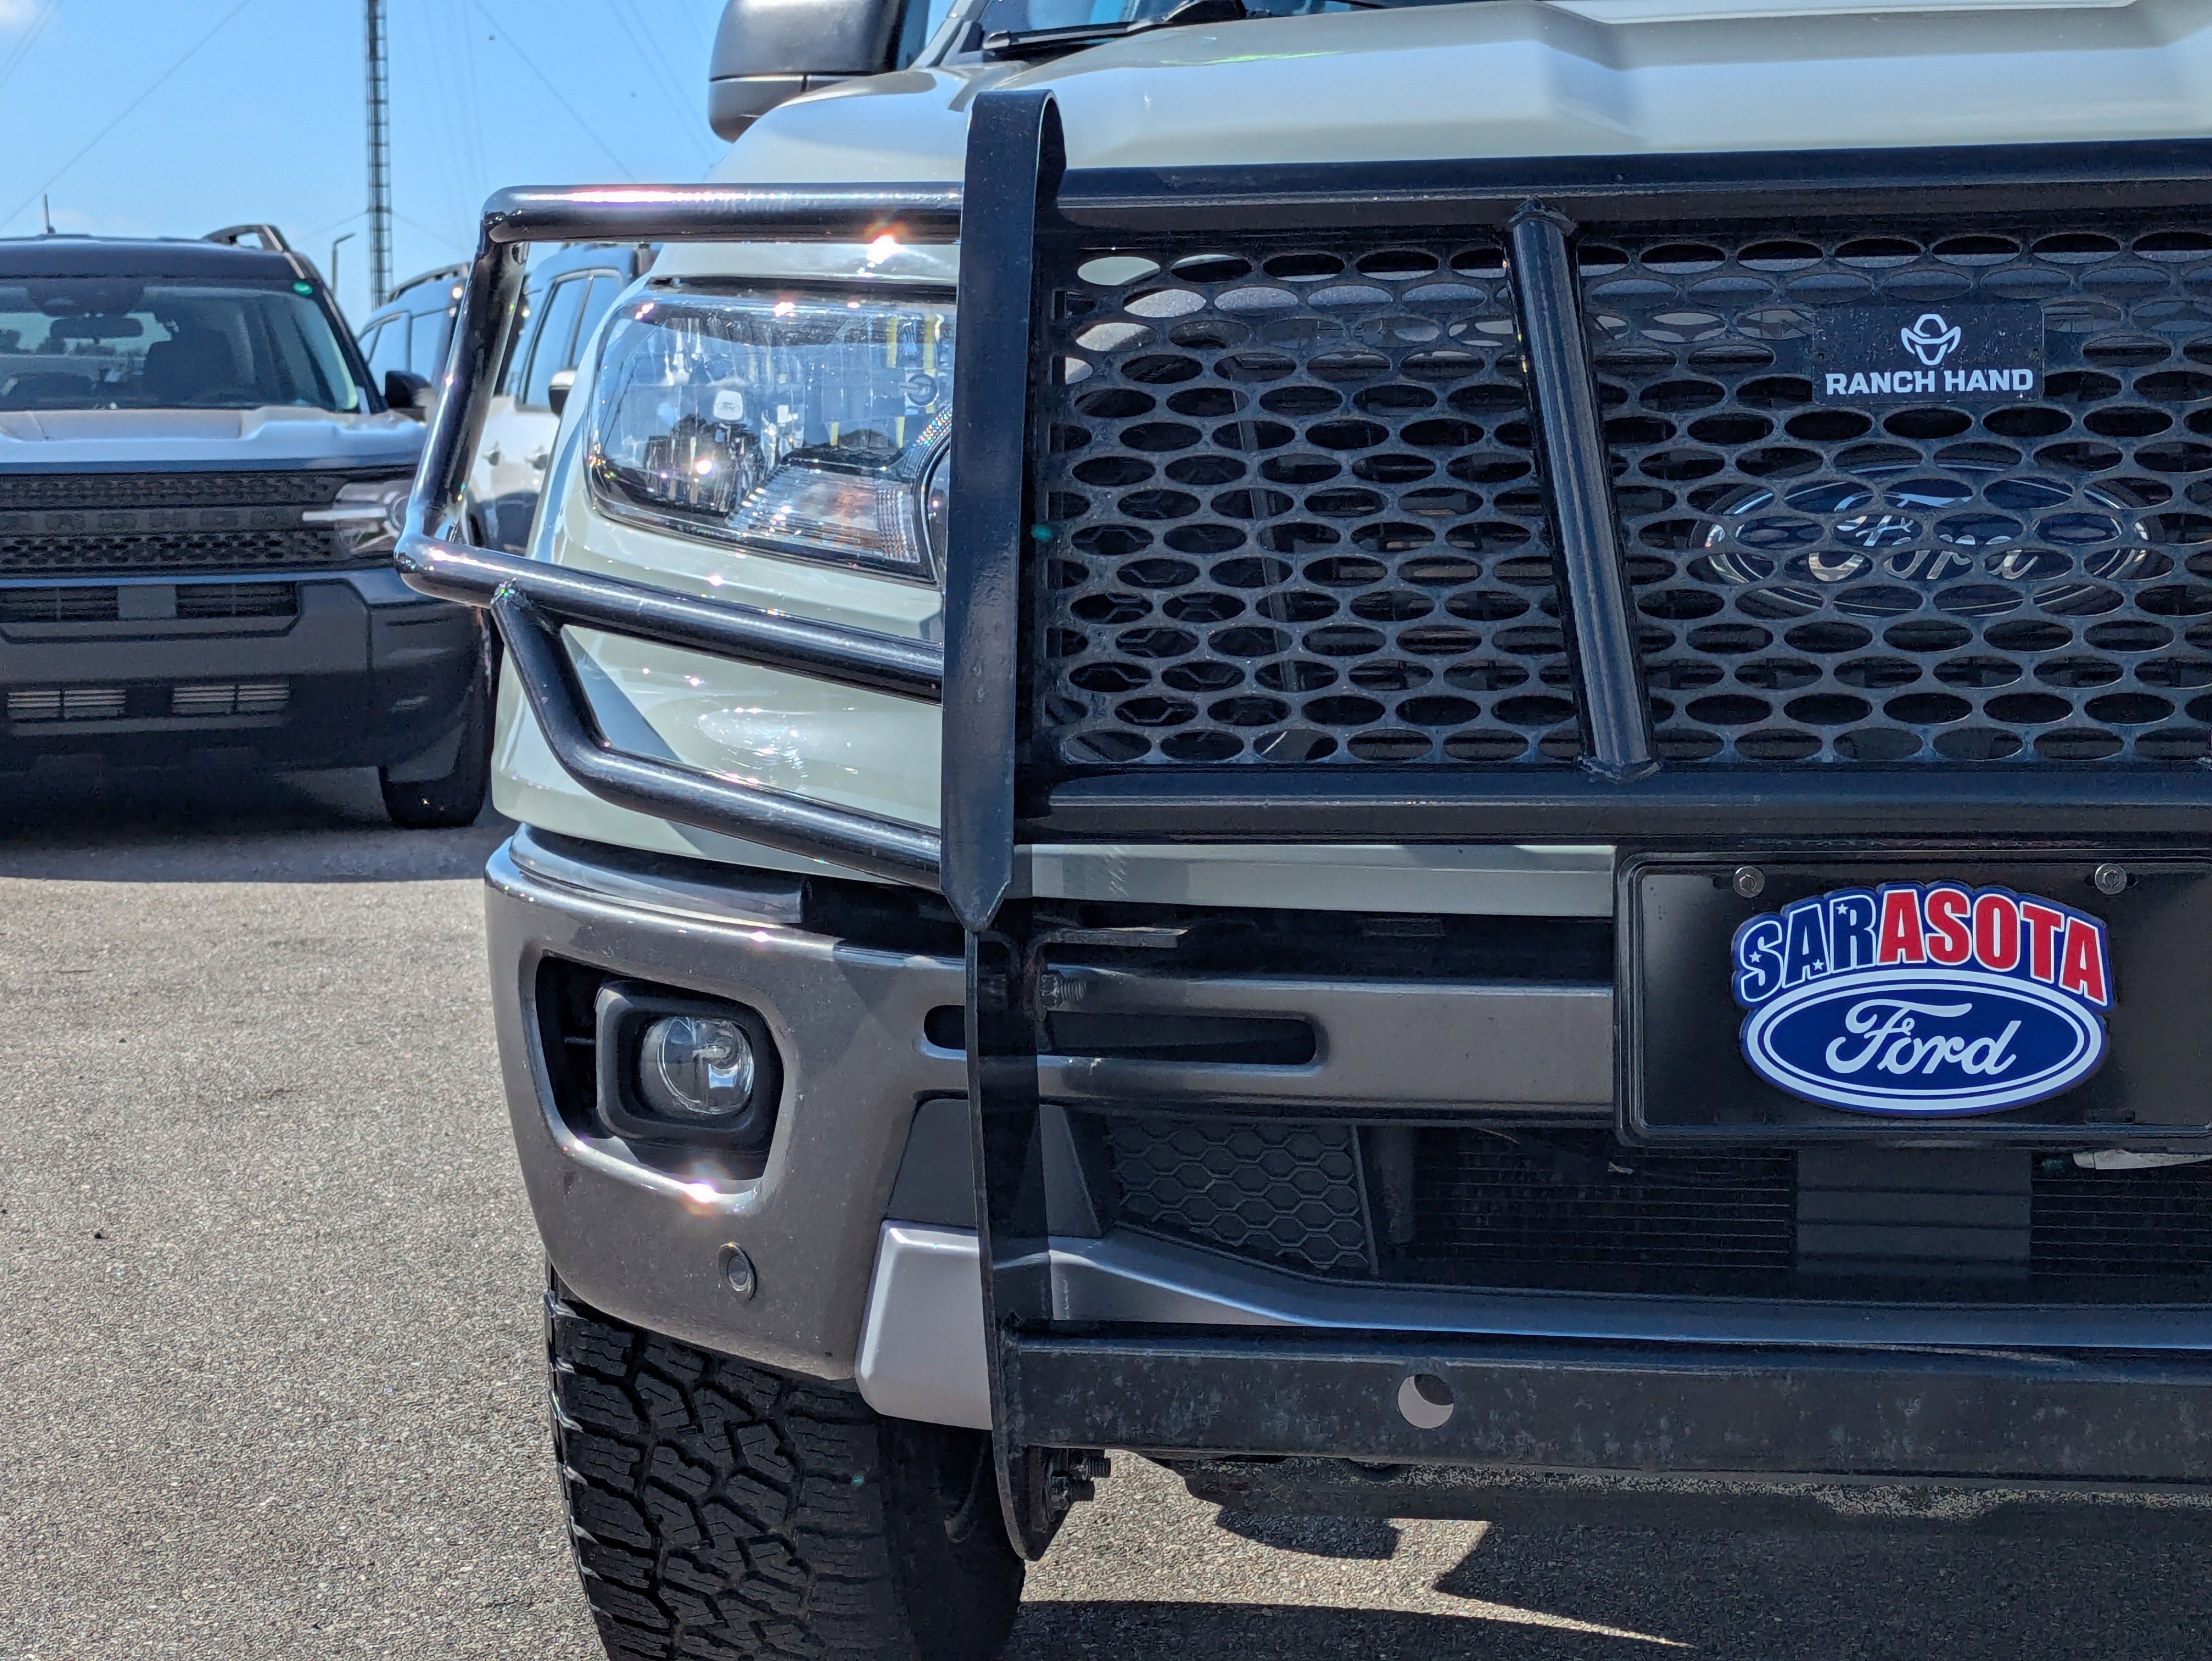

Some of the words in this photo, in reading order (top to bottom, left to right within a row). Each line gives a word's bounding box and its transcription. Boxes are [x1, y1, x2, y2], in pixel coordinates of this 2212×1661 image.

[1825, 370, 1935, 395] RANCH
[1944, 369, 2033, 391] HAND
[1740, 888, 2108, 1006] SARASOTA
[1825, 998, 2022, 1075] Ford
